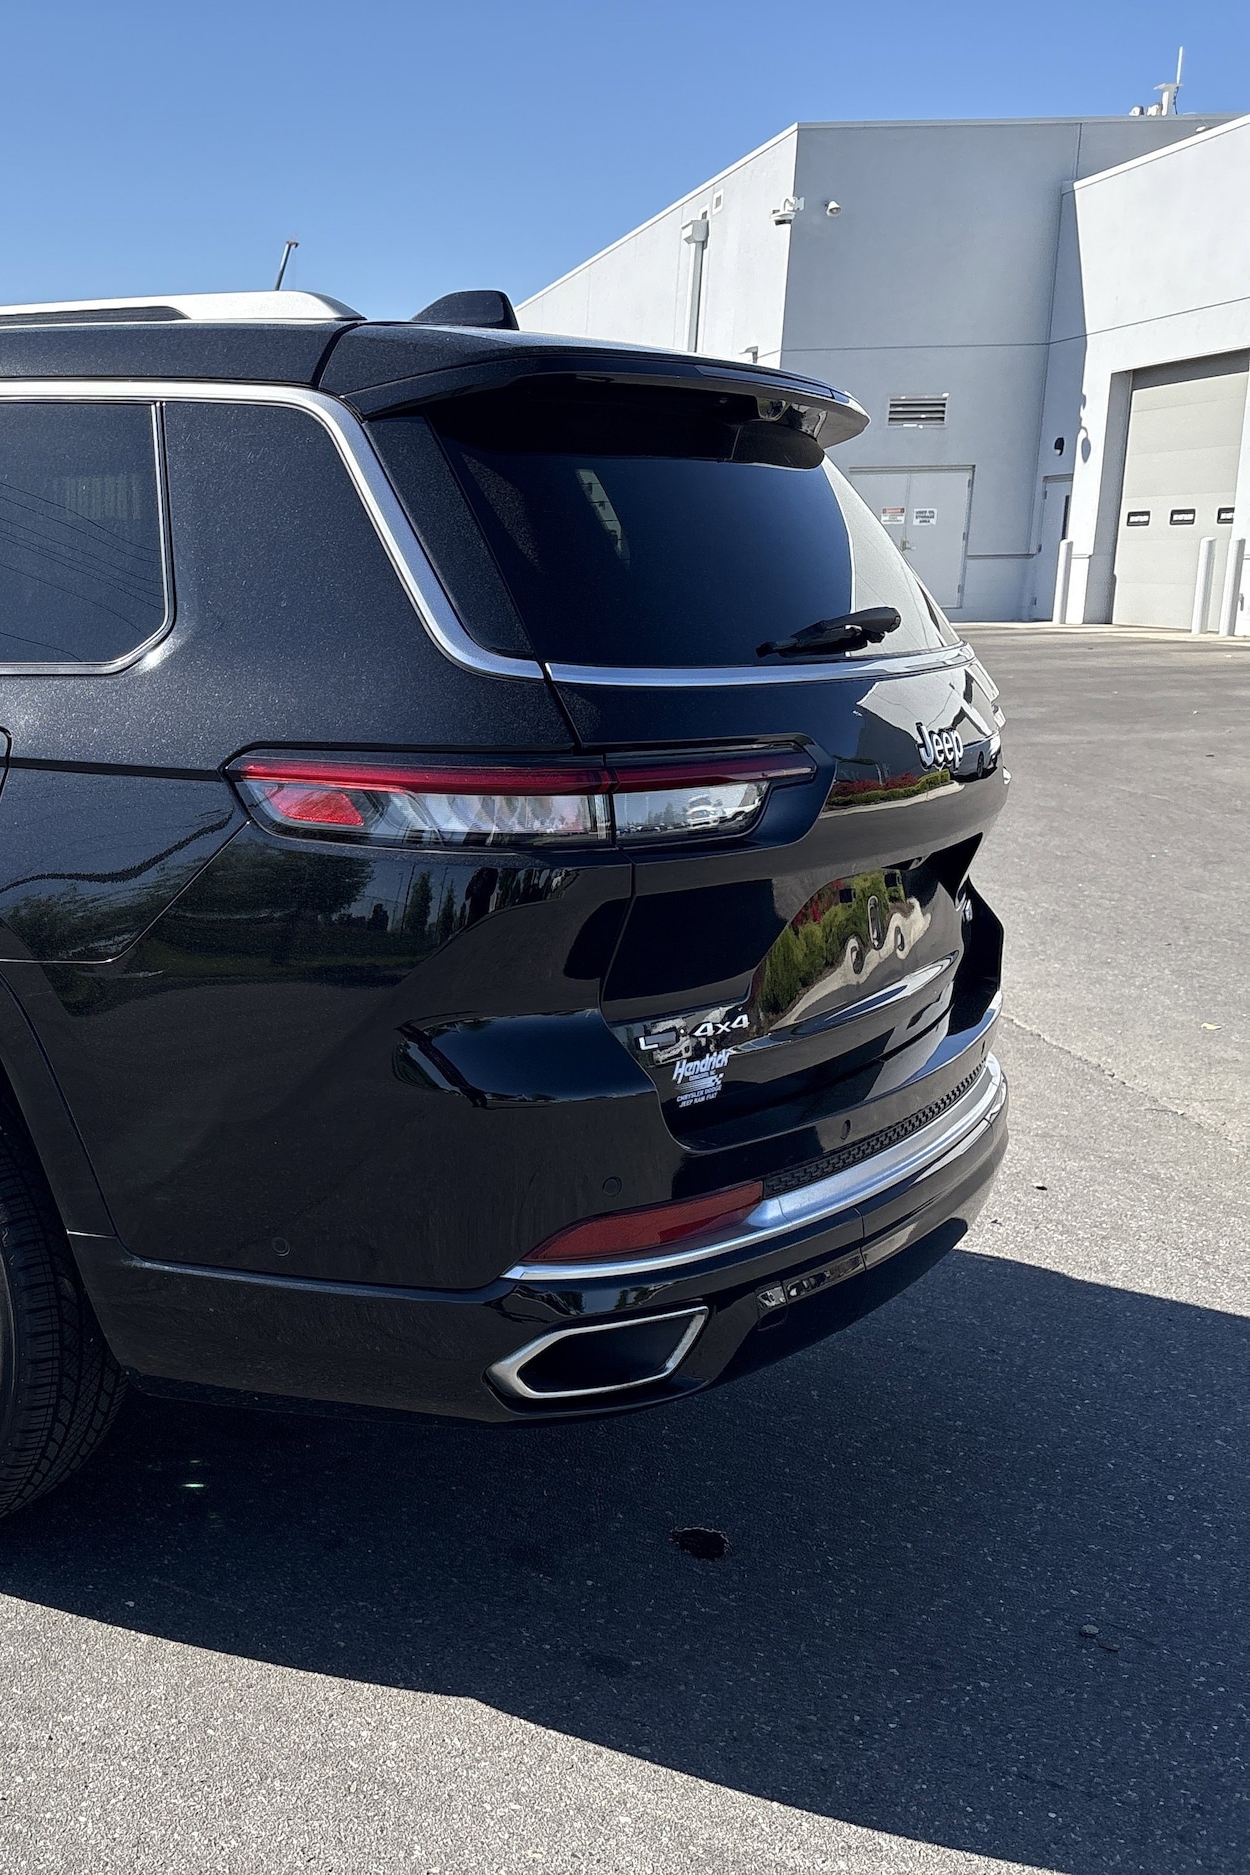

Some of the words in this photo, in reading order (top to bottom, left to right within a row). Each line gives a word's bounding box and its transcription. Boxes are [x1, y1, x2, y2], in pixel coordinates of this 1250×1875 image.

[917, 723, 963, 770] Jeep
[694, 1013, 750, 1037] 4x4
[638, 1036, 659, 1051] L
[672, 1049, 730, 1084] Hendrick
